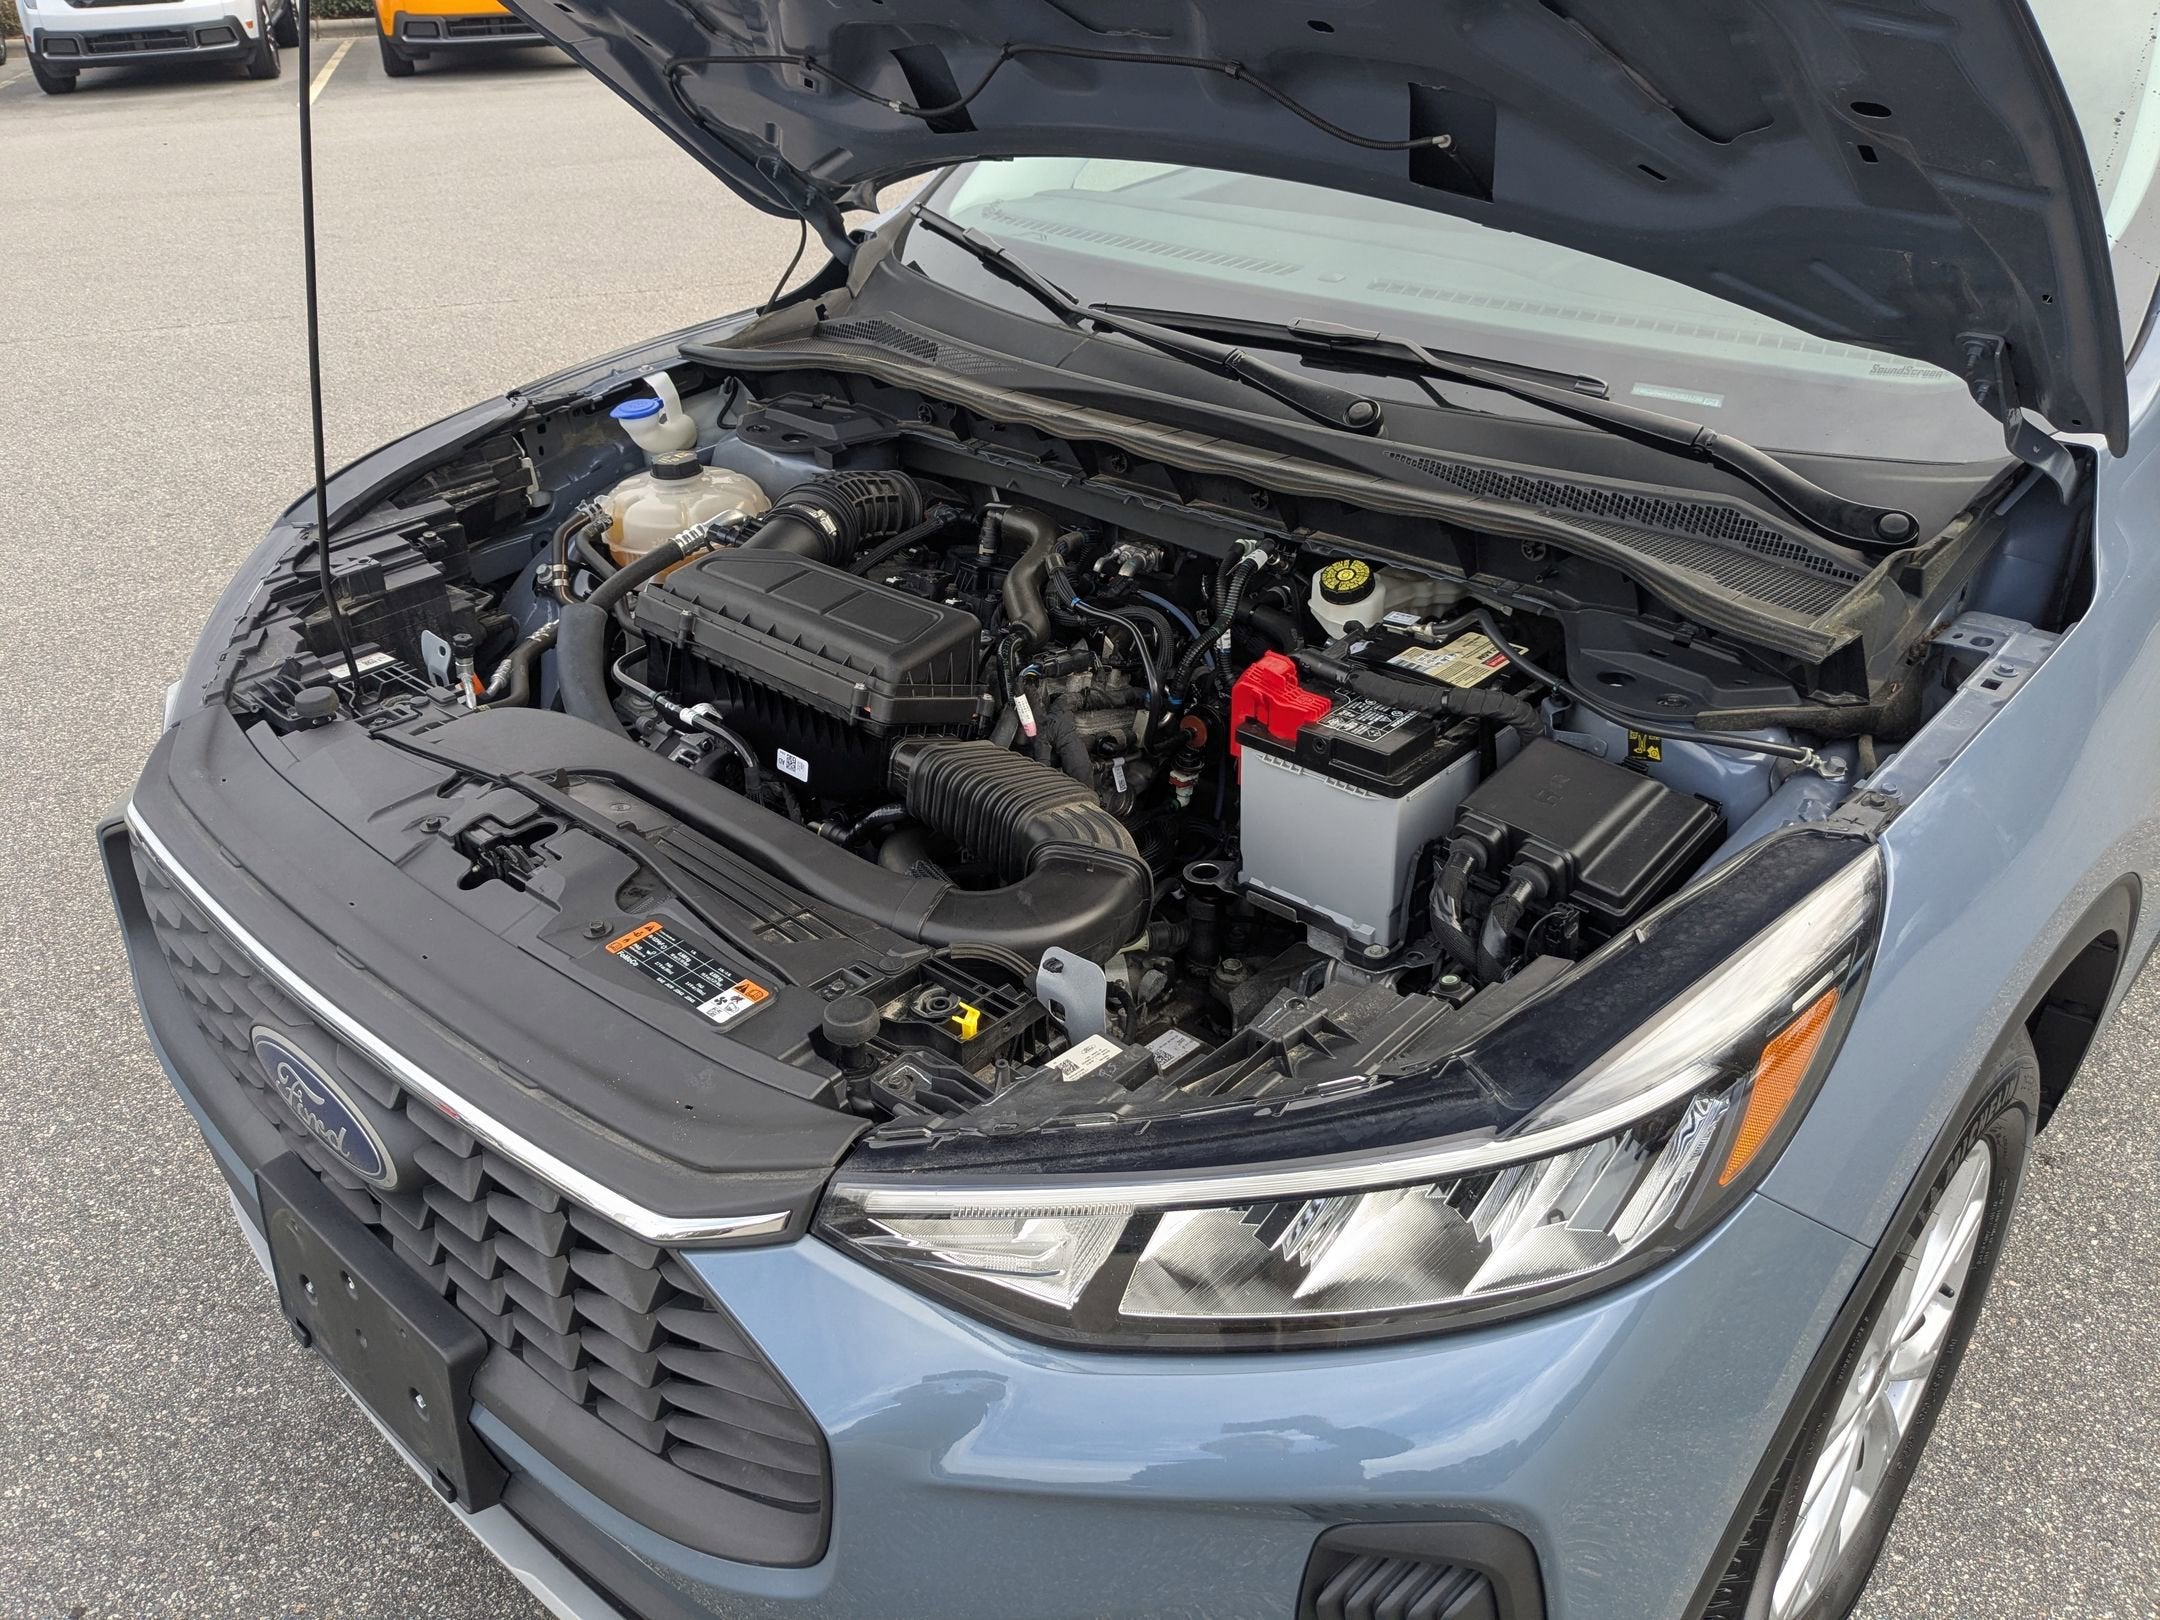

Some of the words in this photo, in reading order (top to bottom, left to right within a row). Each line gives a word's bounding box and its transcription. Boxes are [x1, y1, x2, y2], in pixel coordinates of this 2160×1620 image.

[1869, 363, 1945, 378] SoundScreen
[616, 951, 639, 966] FoMoCo
[276, 1061, 350, 1158] Ford
